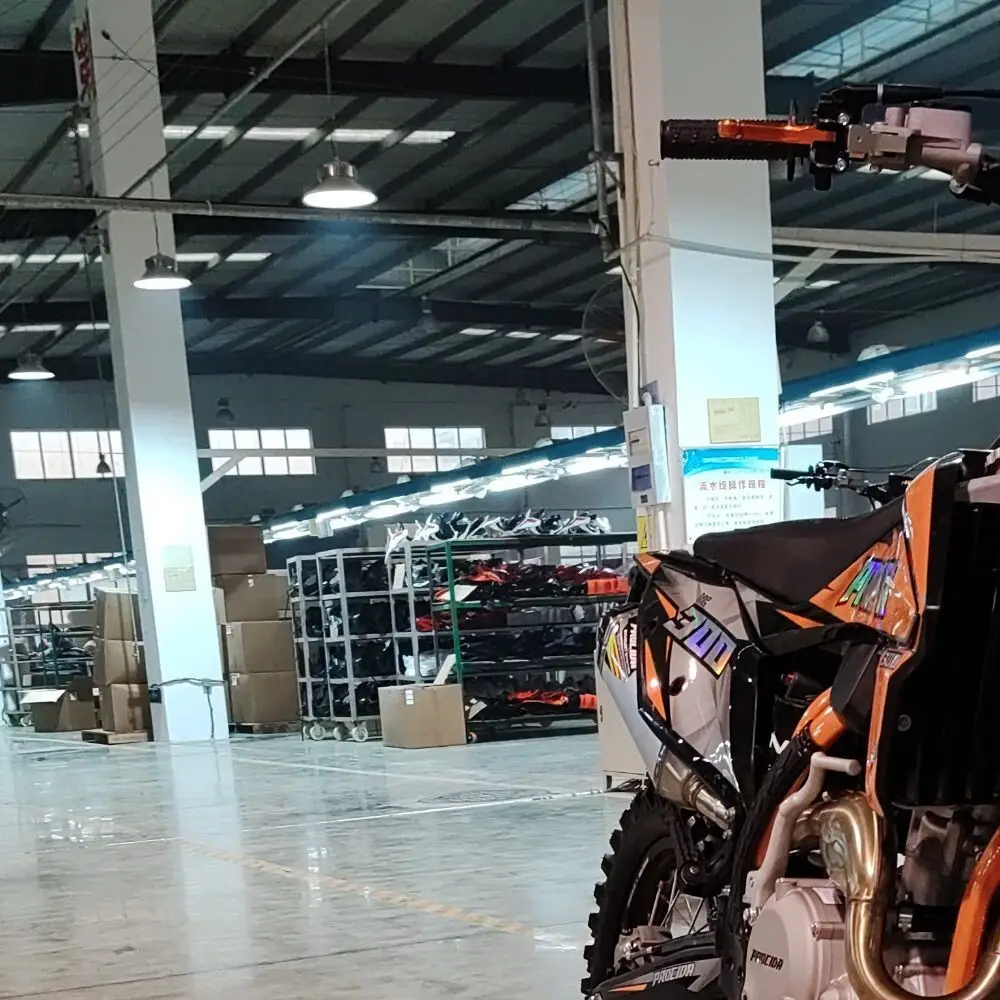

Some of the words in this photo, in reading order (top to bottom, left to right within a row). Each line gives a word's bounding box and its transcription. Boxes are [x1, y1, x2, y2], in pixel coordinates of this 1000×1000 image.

[662, 606, 737, 677] 300
[749, 948, 784, 971] PROCIDA
[651, 962, 695, 988] PROCIDA
